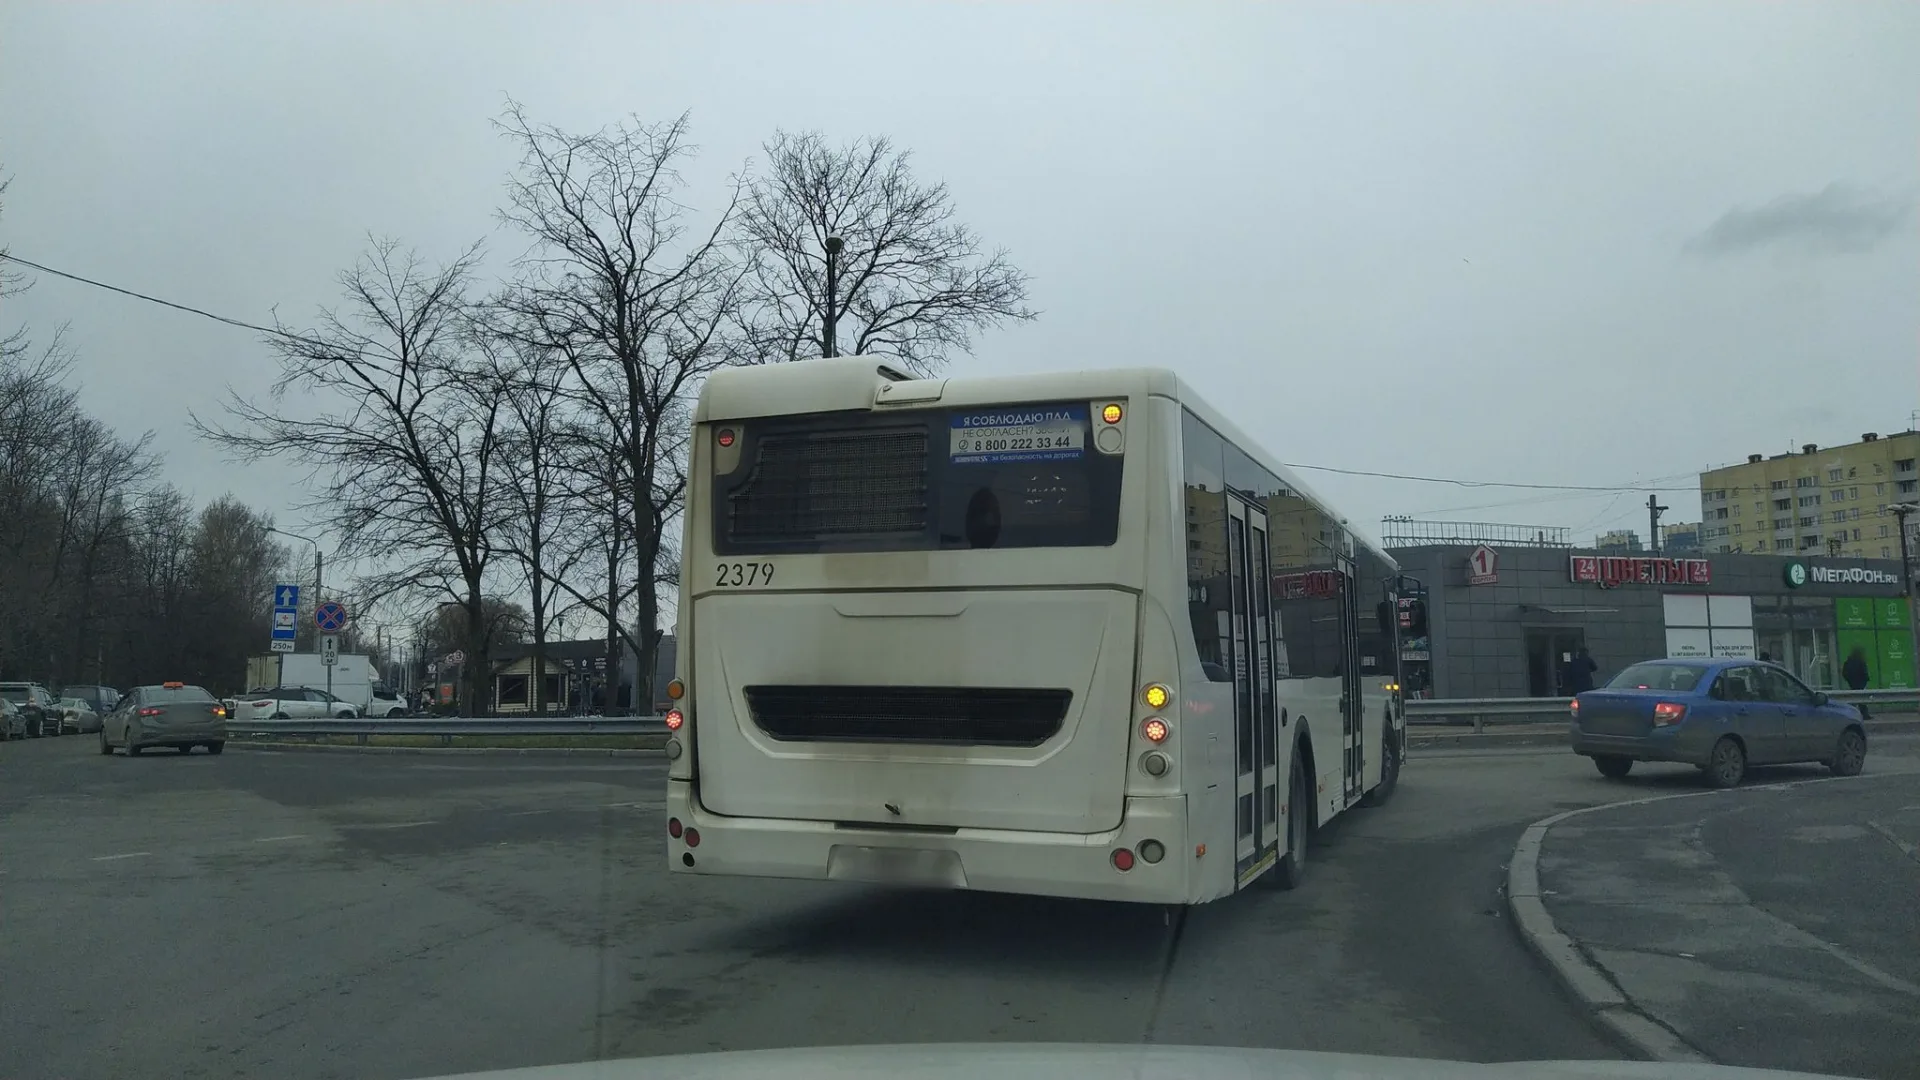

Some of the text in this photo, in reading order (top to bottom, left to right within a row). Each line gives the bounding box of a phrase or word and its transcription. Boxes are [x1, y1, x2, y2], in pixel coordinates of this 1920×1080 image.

[963, 417, 970, 427] Я
[971, 412, 1044, 426] СОБЛЮДАЮ
[962, 429, 975, 438] НЕ
[976, 426, 1034, 437] СОГЛАСЕН?
[974, 436, 1070, 451] 8 800 222 33 44
[1000, 453, 1042, 461] безопасность
[1475, 550, 1487, 574] 1
[1579, 559, 1595, 573] 24
[1694, 562, 1708, 575] 24
[715, 562, 775, 587] 2379
[1600, 557, 1686, 587] ЦВЕТЫ
